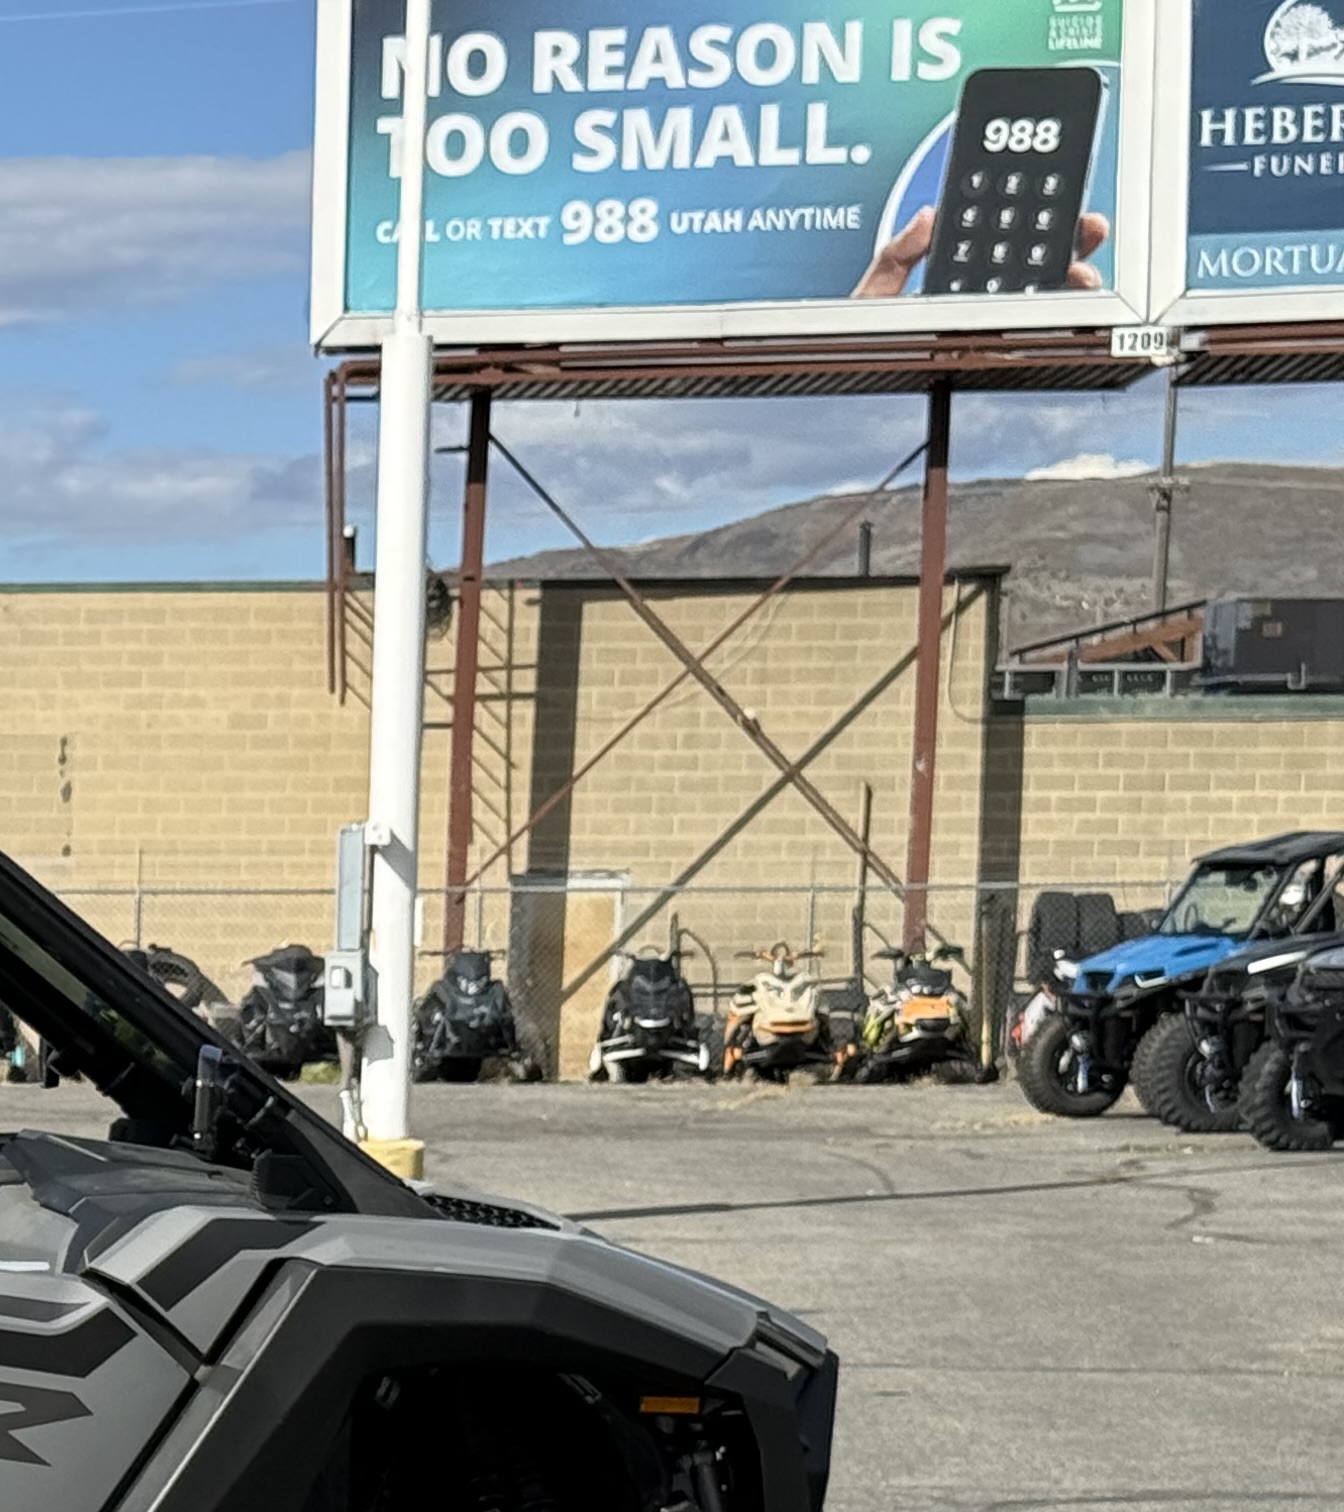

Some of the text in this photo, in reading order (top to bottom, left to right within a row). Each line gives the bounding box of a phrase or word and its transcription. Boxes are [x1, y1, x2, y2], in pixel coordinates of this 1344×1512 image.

[381, 17, 962, 99] NO REASON IS
[572, 103, 872, 173] SMALL.
[983, 117, 1061, 153] 988
[1253, 152, 1344, 178] FUNE
[376, 198, 862, 246] CL OR TEXT 988 UTAH ANYTIME
